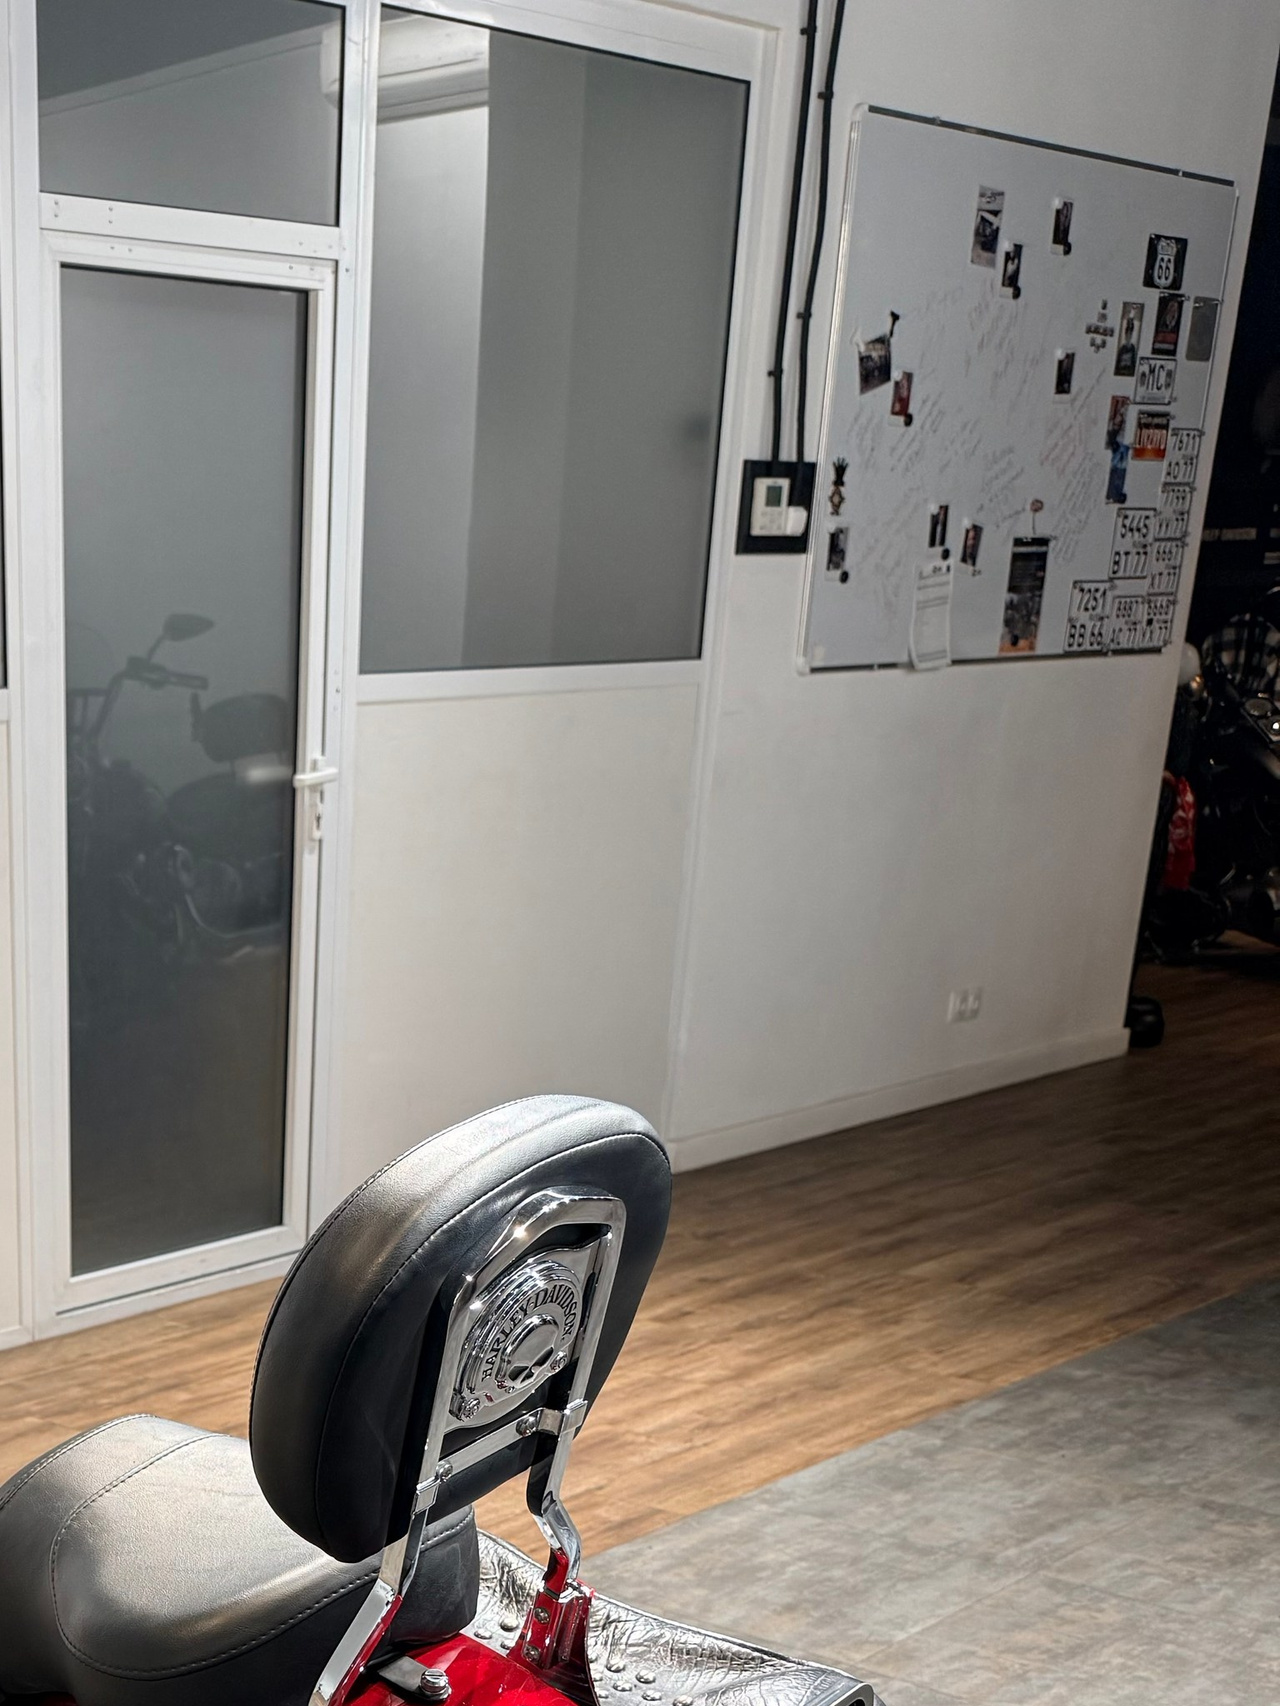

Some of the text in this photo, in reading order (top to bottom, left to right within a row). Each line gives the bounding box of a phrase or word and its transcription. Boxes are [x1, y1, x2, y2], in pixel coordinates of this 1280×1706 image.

[1157, 257, 1173, 281] 66
[1146, 363, 1166, 391] MC
[1120, 514, 1150, 539] 5445
[1112, 550, 1148, 574] BT 77
[1077, 587, 1107, 612] 7251
[1067, 622, 1103, 648] BB 66
[481, 1283, 578, 1383] HARLEY-DAVIDSON
